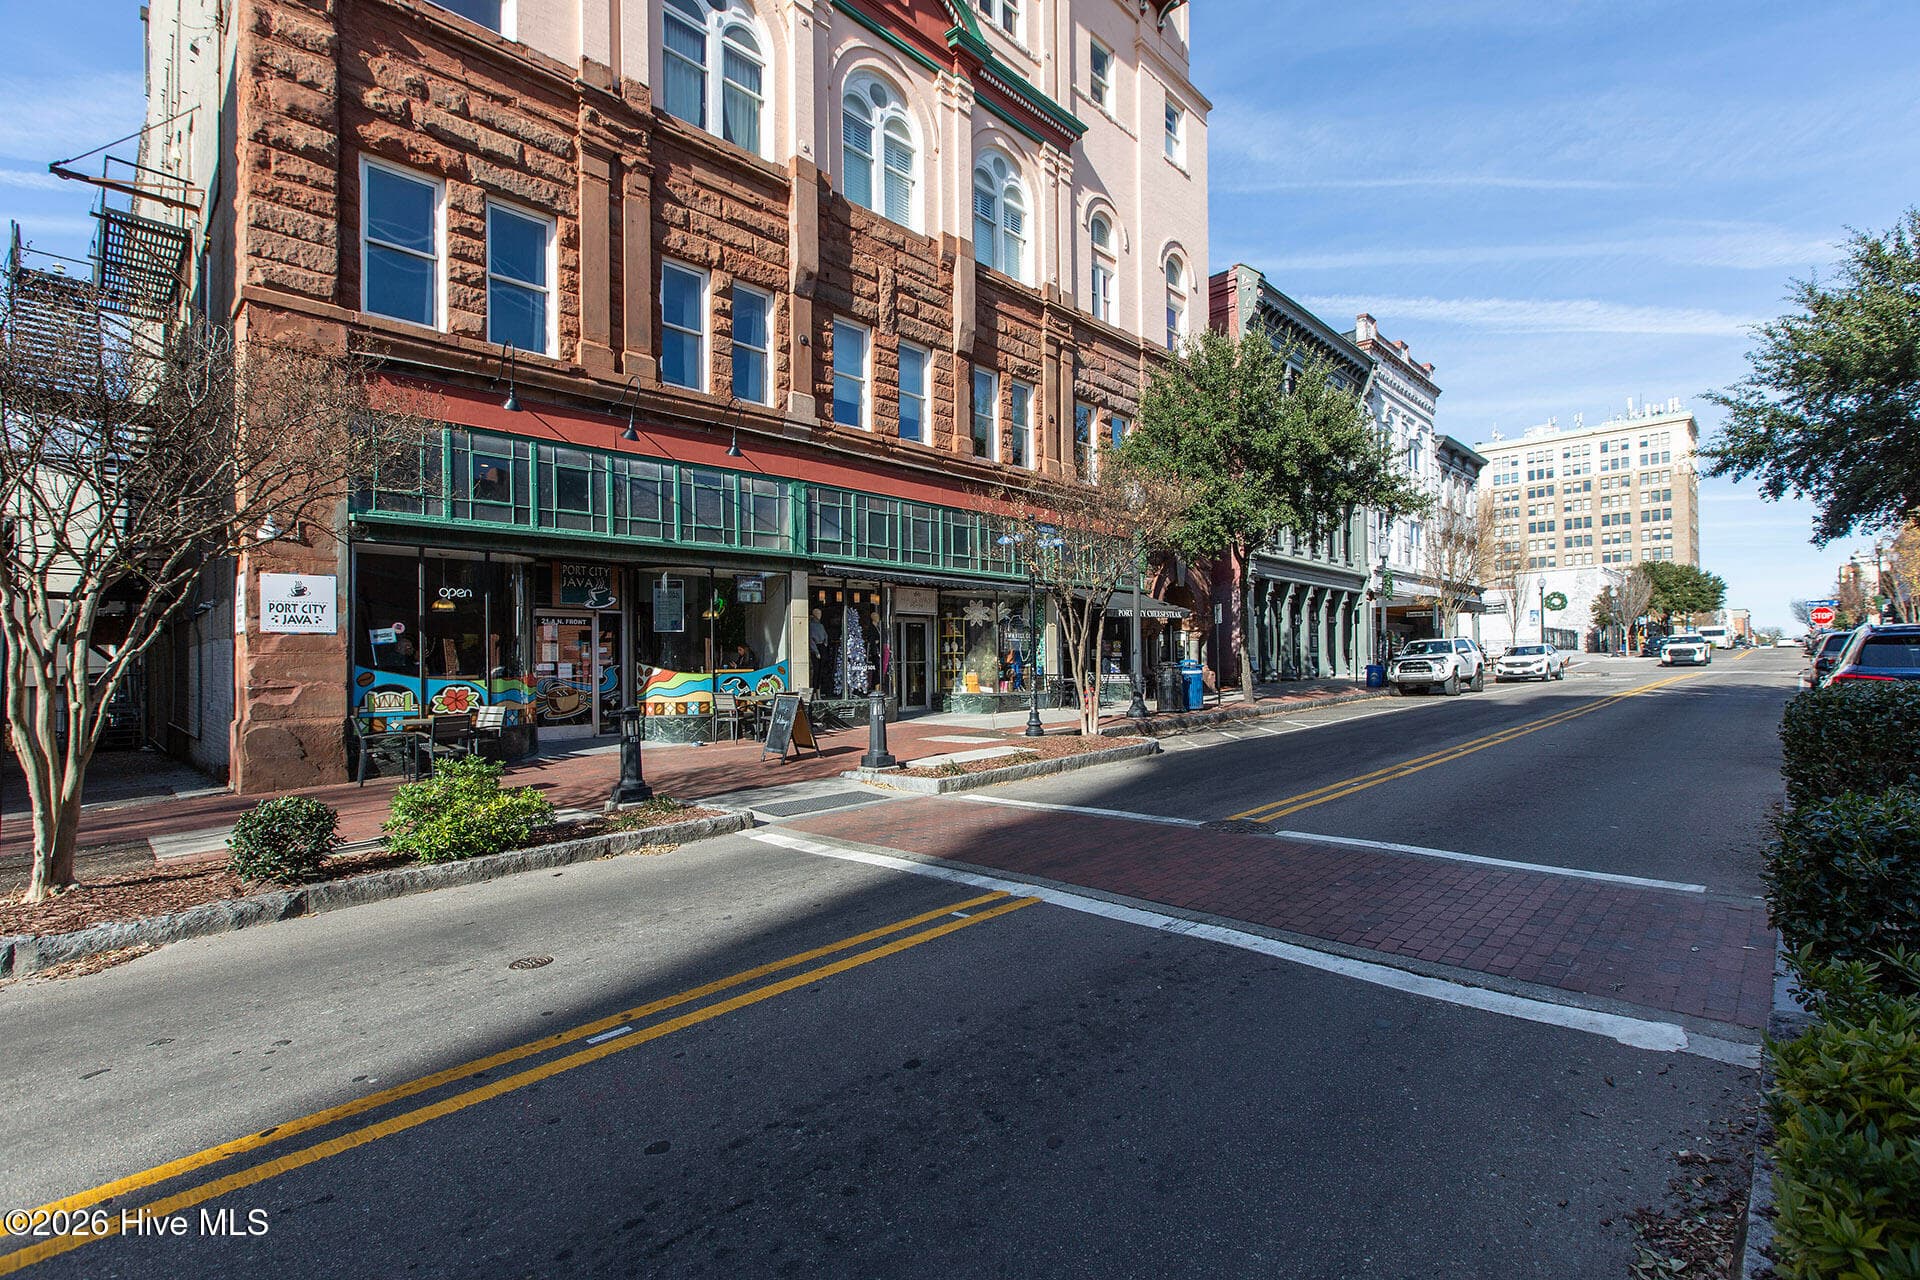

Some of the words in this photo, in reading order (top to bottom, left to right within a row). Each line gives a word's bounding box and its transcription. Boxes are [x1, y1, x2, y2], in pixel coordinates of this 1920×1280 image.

[562, 564, 587, 576] PORT
[588, 566, 610, 577] CITY
[562, 577, 594, 588] JAVA
[438, 587, 473, 600] open
[268, 602, 299, 613] PORT
[301, 603, 327, 614] CITY
[1118, 609, 1133, 617] PORT
[282, 614, 312, 625] JAVA
[1811, 612, 1833, 620] STOP
